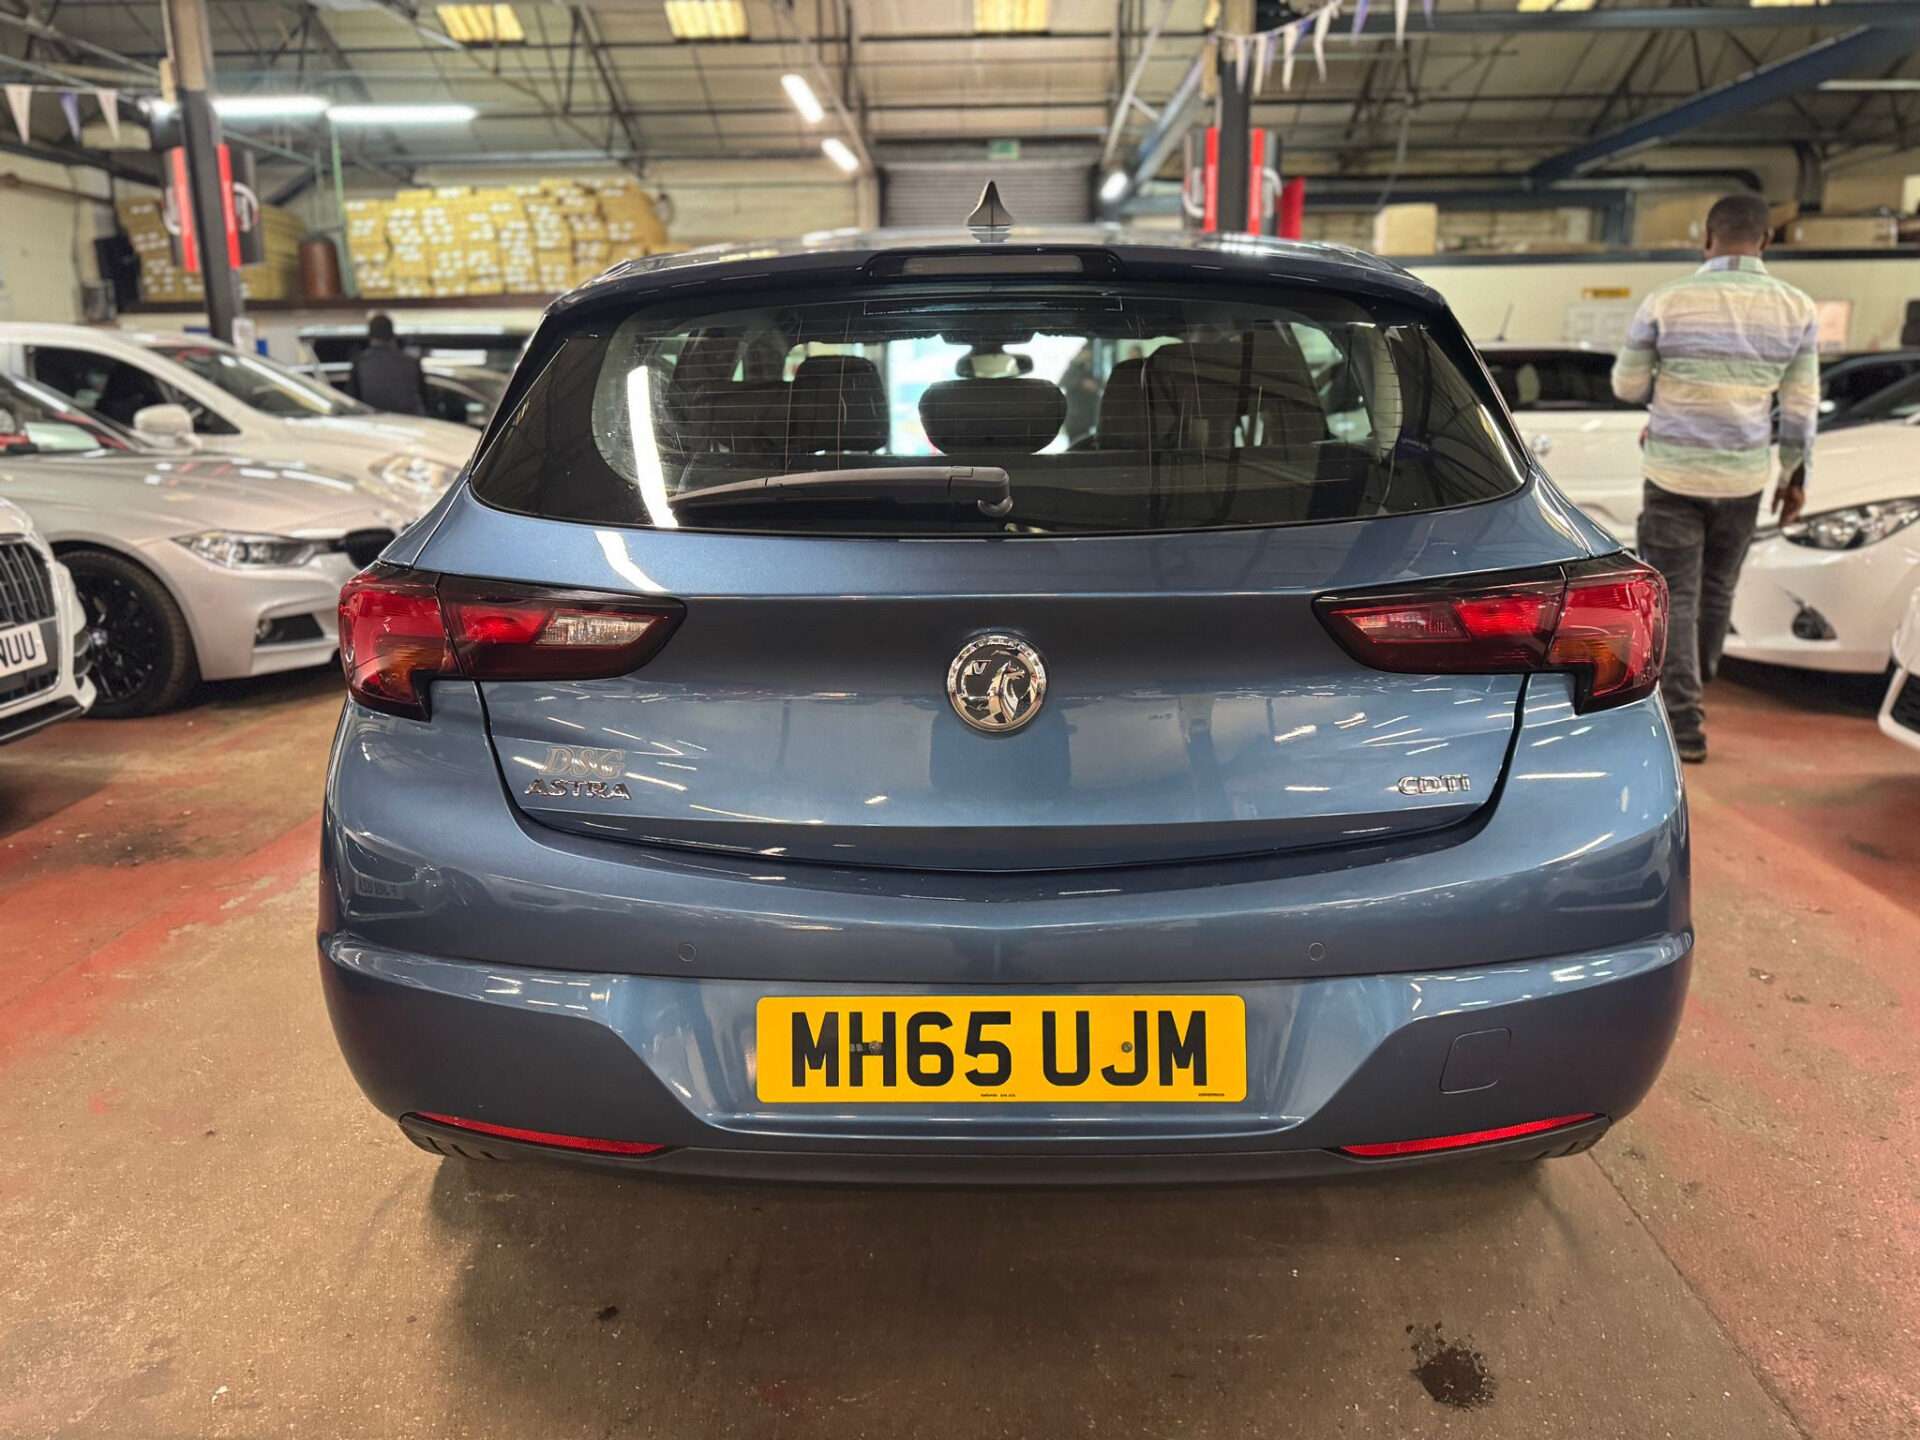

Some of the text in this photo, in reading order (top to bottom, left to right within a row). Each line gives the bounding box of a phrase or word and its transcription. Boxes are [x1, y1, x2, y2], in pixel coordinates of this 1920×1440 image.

[538, 746, 624, 778] DSG
[524, 779, 632, 800] ASTRA
[792, 1010, 1207, 1088] MH65 UJM
